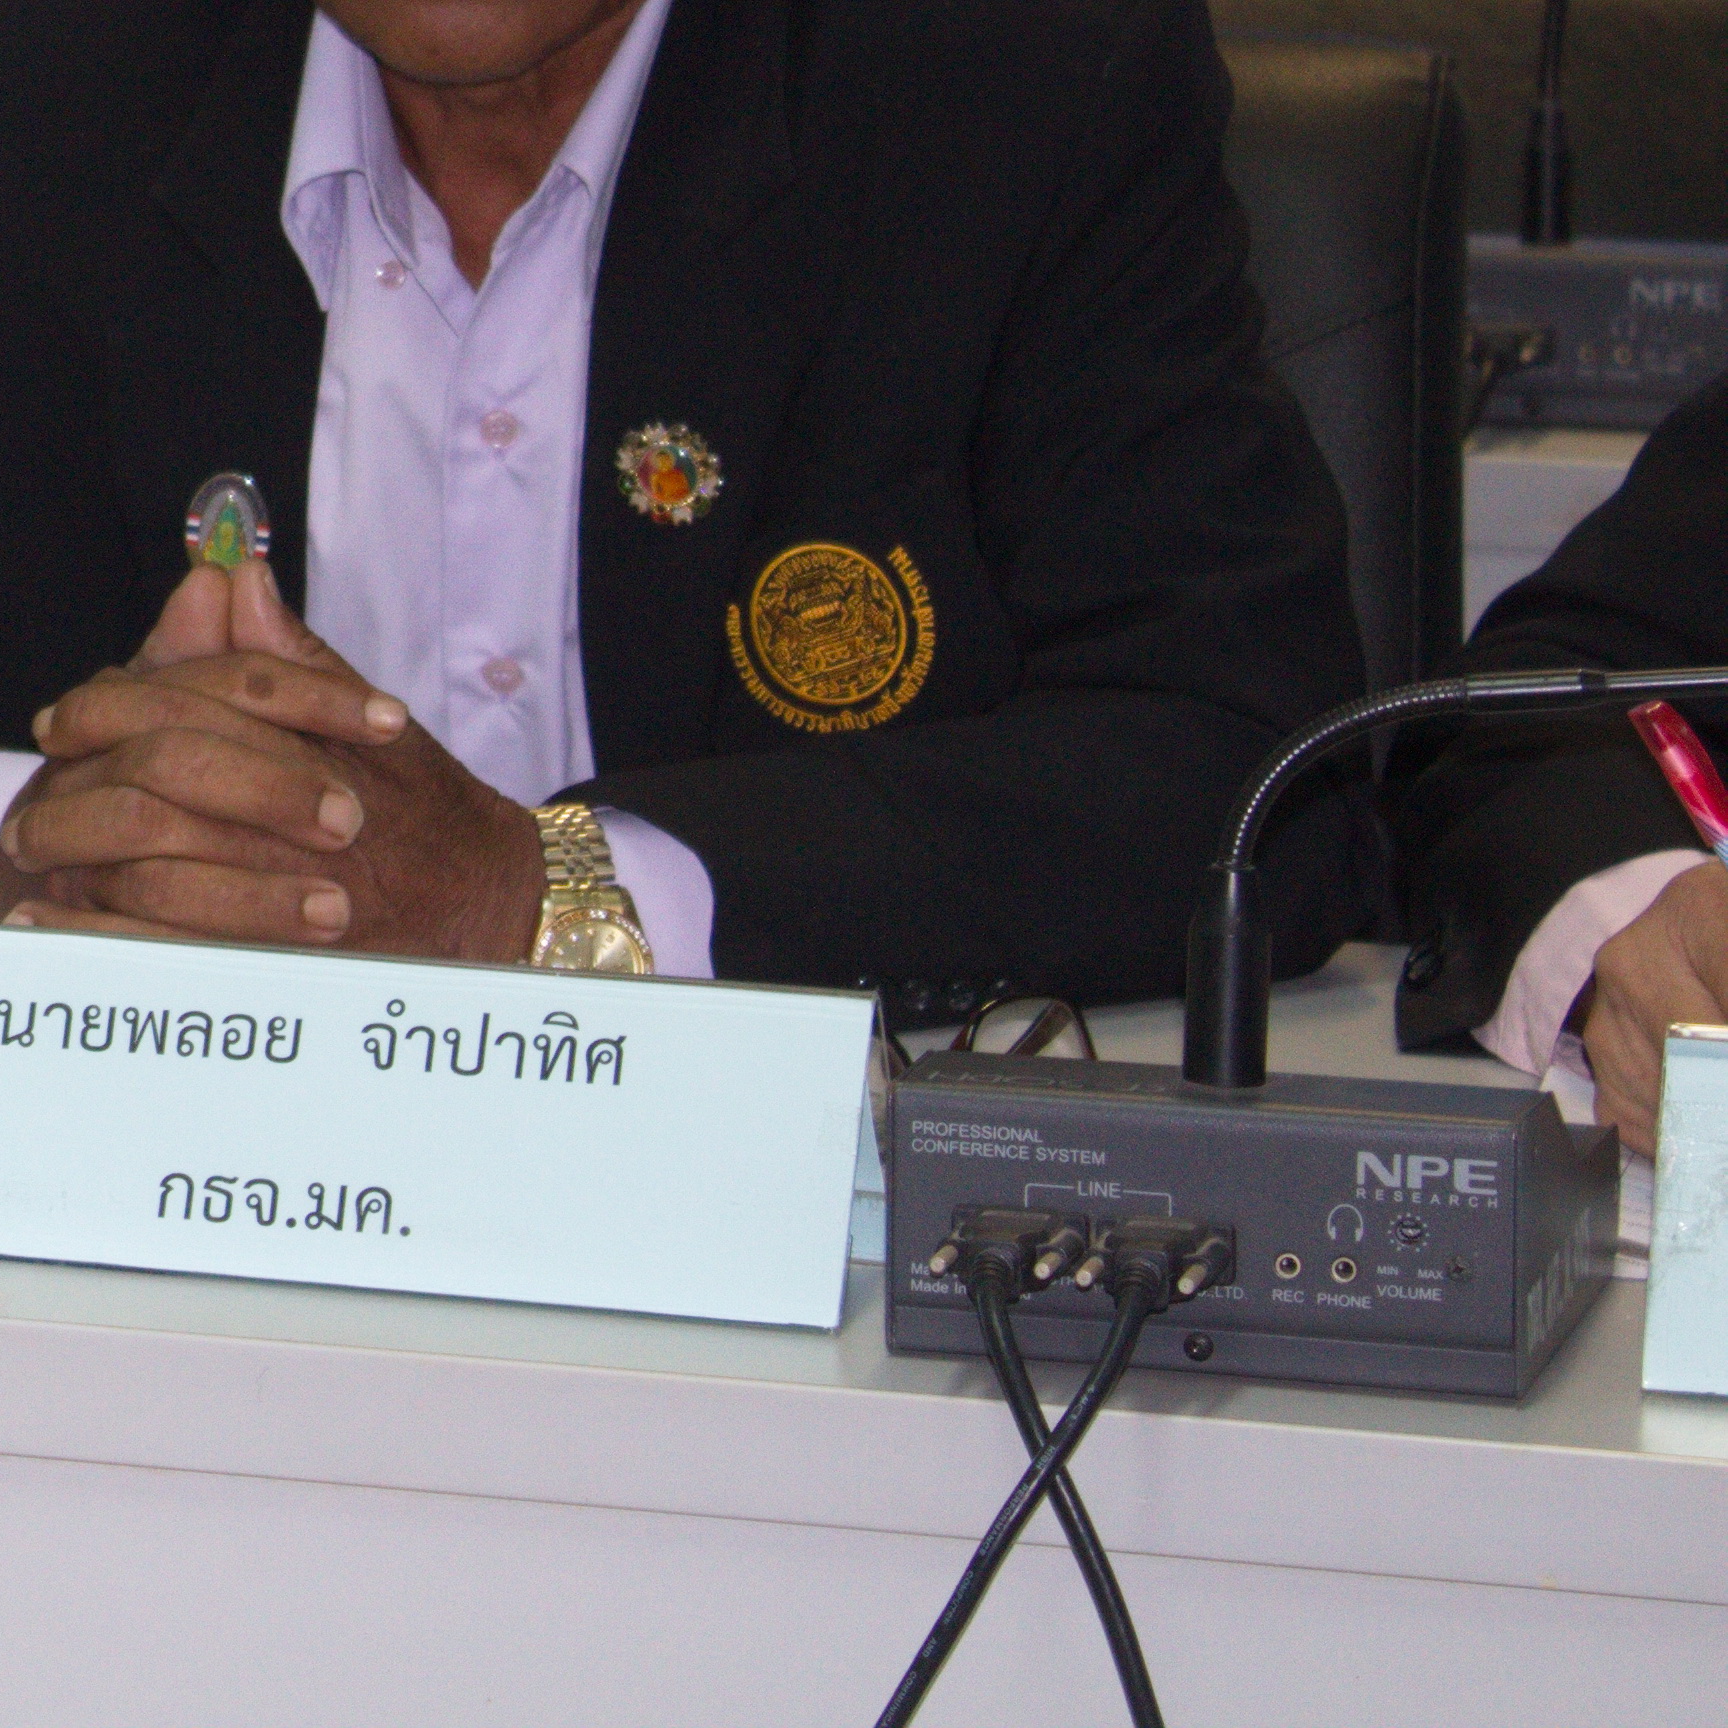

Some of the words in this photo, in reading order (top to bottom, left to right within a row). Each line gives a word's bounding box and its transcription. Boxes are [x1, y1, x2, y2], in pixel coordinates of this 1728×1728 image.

[361, 998, 627, 1086] จำปาทิศ
[911, 1120, 1044, 1143] PROFESSIONAL
[911, 1138, 1030, 1160] CONFERENCE
[1035, 1147, 1106, 1166] SYSTEM
[1355, 1150, 1498, 1196] NPE
[1076, 1180, 1122, 1199] LINE
[1355, 1187, 1498, 1209] RESEARCH
[157, 1172, 411, 1237] กธจ.มค.
[1376, 1265, 1399, 1277] MIN
[1417, 1268, 1444, 1280] MAX
[910, 1278, 949, 1294] Made
[954, 1280, 967, 1294] In
[1272, 1288, 1305, 1304] REC
[1376, 1284, 1443, 1302] VOLUME
[1316, 1292, 1372, 1310] PHONE
[981, 1482, 1029, 1556] PERFORMANCE
[922, 1636, 938, 1658] AND
